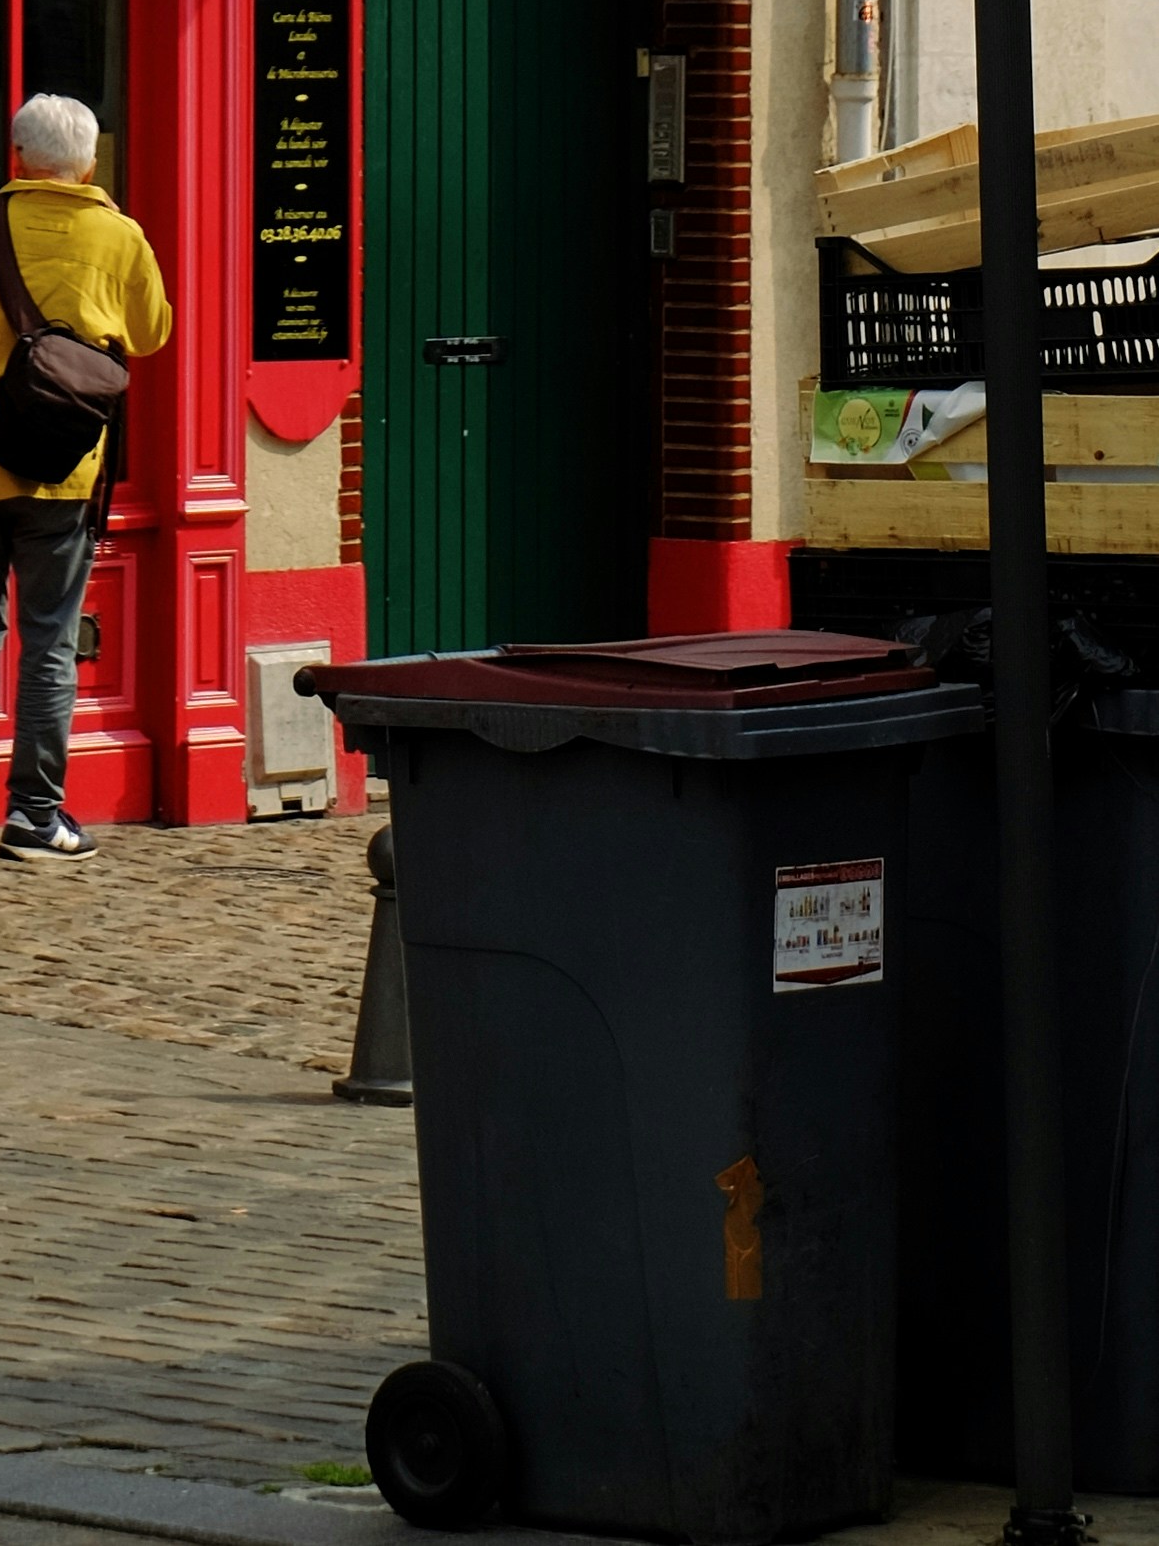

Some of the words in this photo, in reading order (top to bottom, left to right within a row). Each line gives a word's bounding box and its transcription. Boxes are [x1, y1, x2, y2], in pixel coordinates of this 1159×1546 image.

[272, 11, 296, 22] Carte
[296, 9, 306, 22] de
[266, 66, 277, 79] de
[275, 136, 287, 149] du
[288, 136, 311, 149] lundi
[312, 138, 328, 149] soir
[271, 160, 283, 168] au
[284, 154, 313, 168] samedi
[314, 157, 329, 168] soir
[315, 211, 328, 220] au
[260, 225, 343, 243] 03.28.36.40.06
